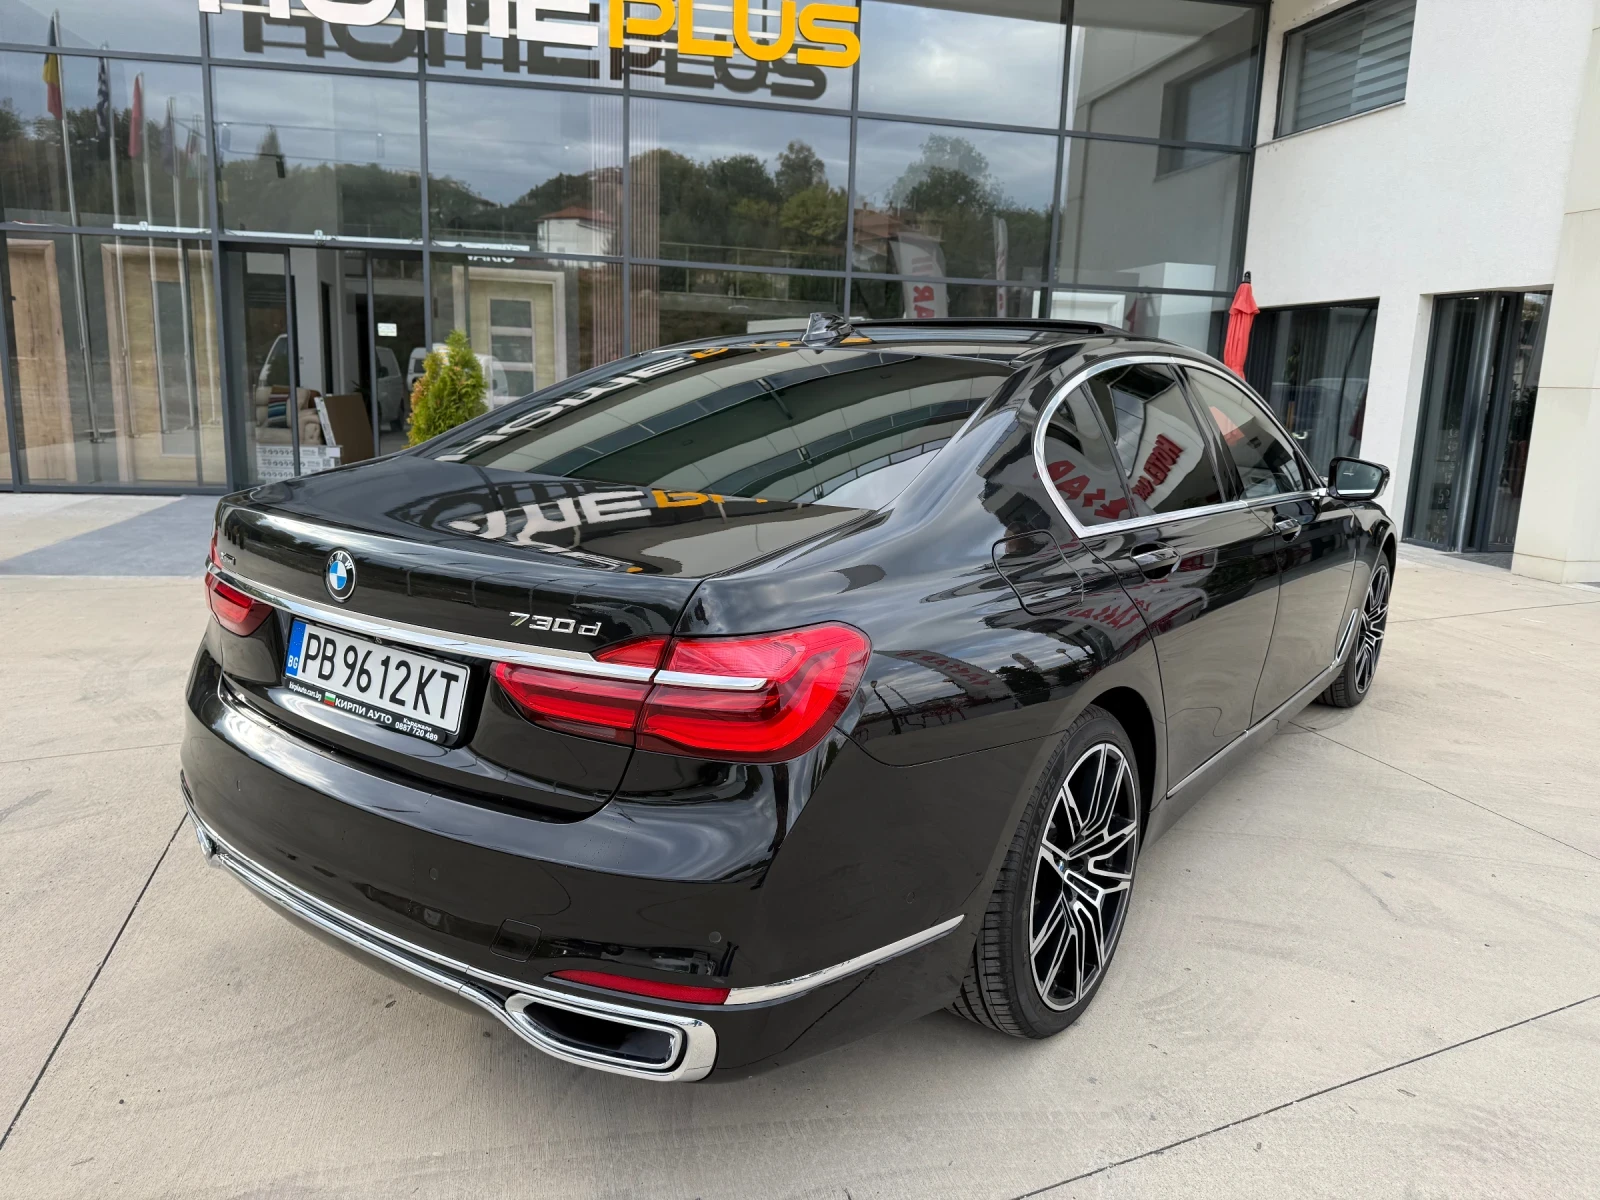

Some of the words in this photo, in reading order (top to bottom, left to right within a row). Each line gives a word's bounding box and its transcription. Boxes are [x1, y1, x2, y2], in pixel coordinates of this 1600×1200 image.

[609, 0, 861, 68] PLUS
[287, 654, 299, 669] BG
[335, 697, 366, 716] КИРПИ
[367, 709, 393, 724] АУТО
[394, 721, 411, 732] 0887
[412, 727, 425, 737] 720
[425, 731, 438, 742] 489
[1022, 823, 1040, 880] ULTRA
